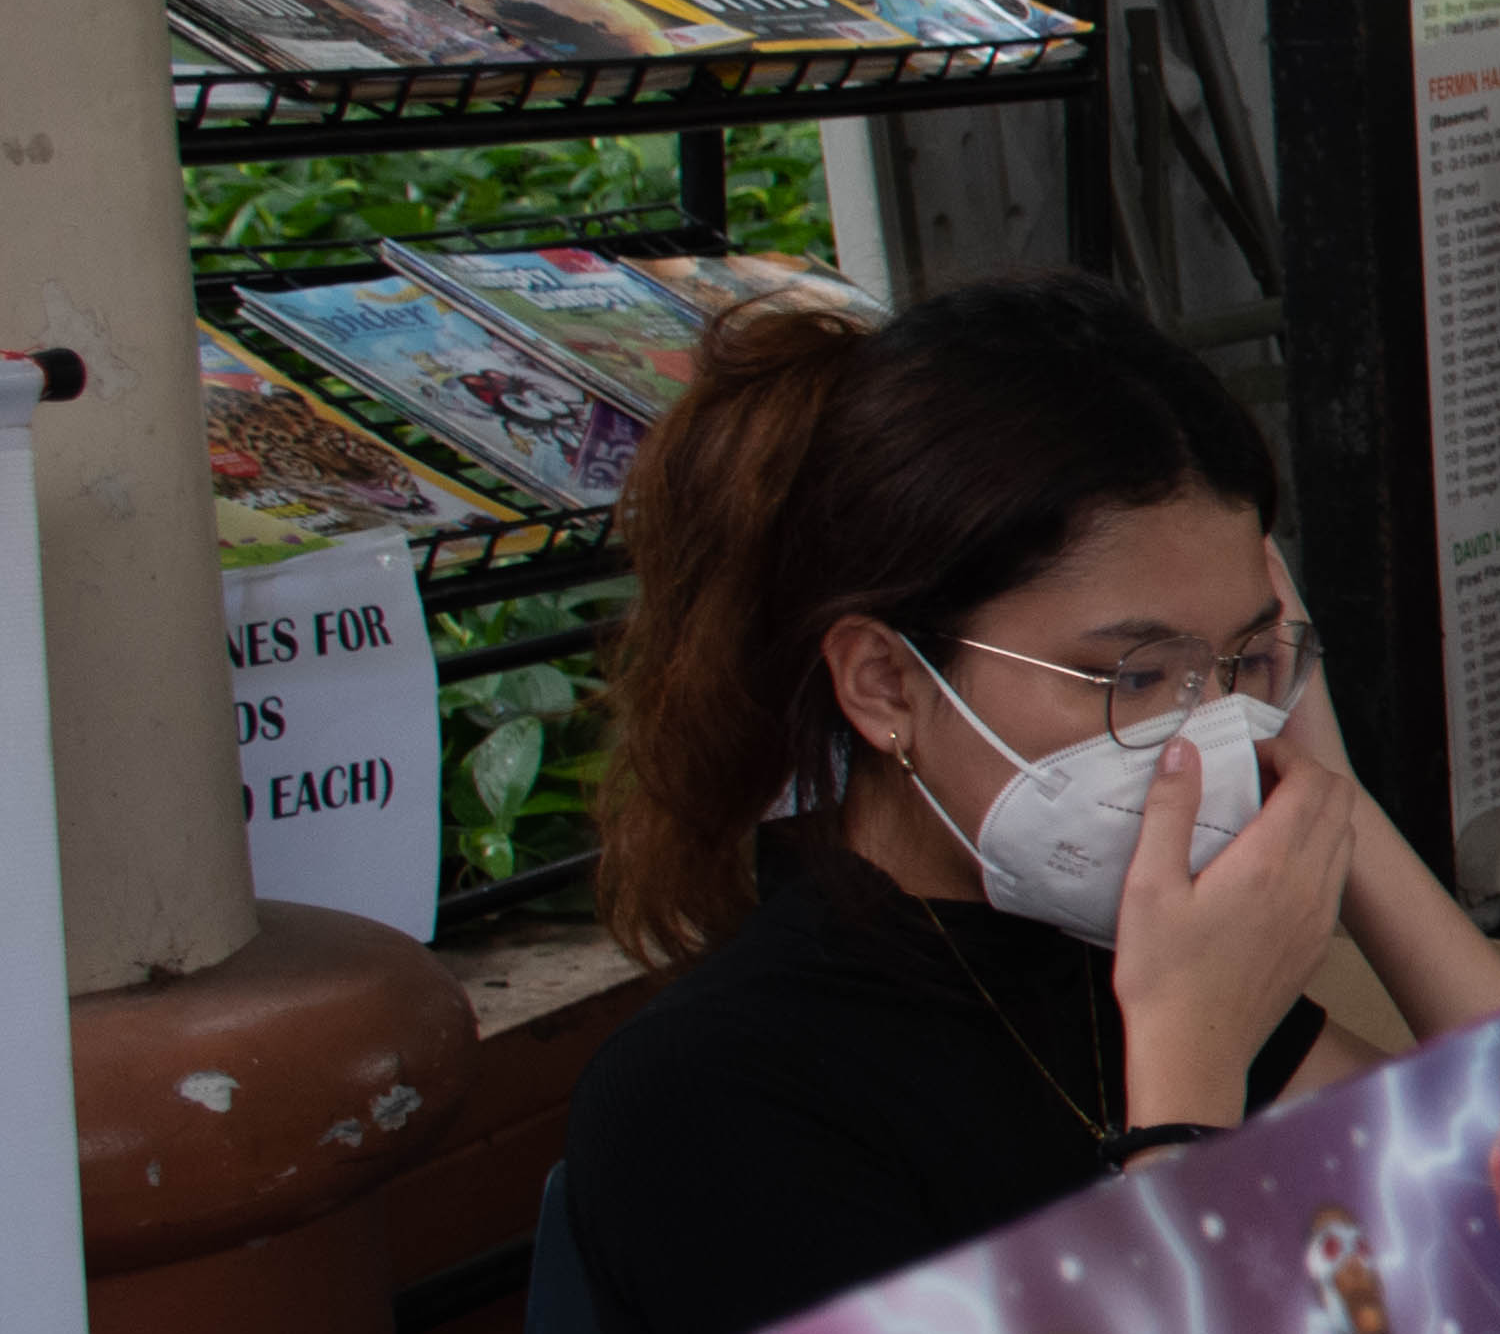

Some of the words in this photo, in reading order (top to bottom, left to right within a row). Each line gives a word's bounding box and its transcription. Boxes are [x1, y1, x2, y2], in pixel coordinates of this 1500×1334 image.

[1428, 71, 1479, 102] FERMIN
[1452, 531, 1491, 565] DAVID
[314, 604, 393, 656] FOR
[270, 757, 393, 820] EACH)
